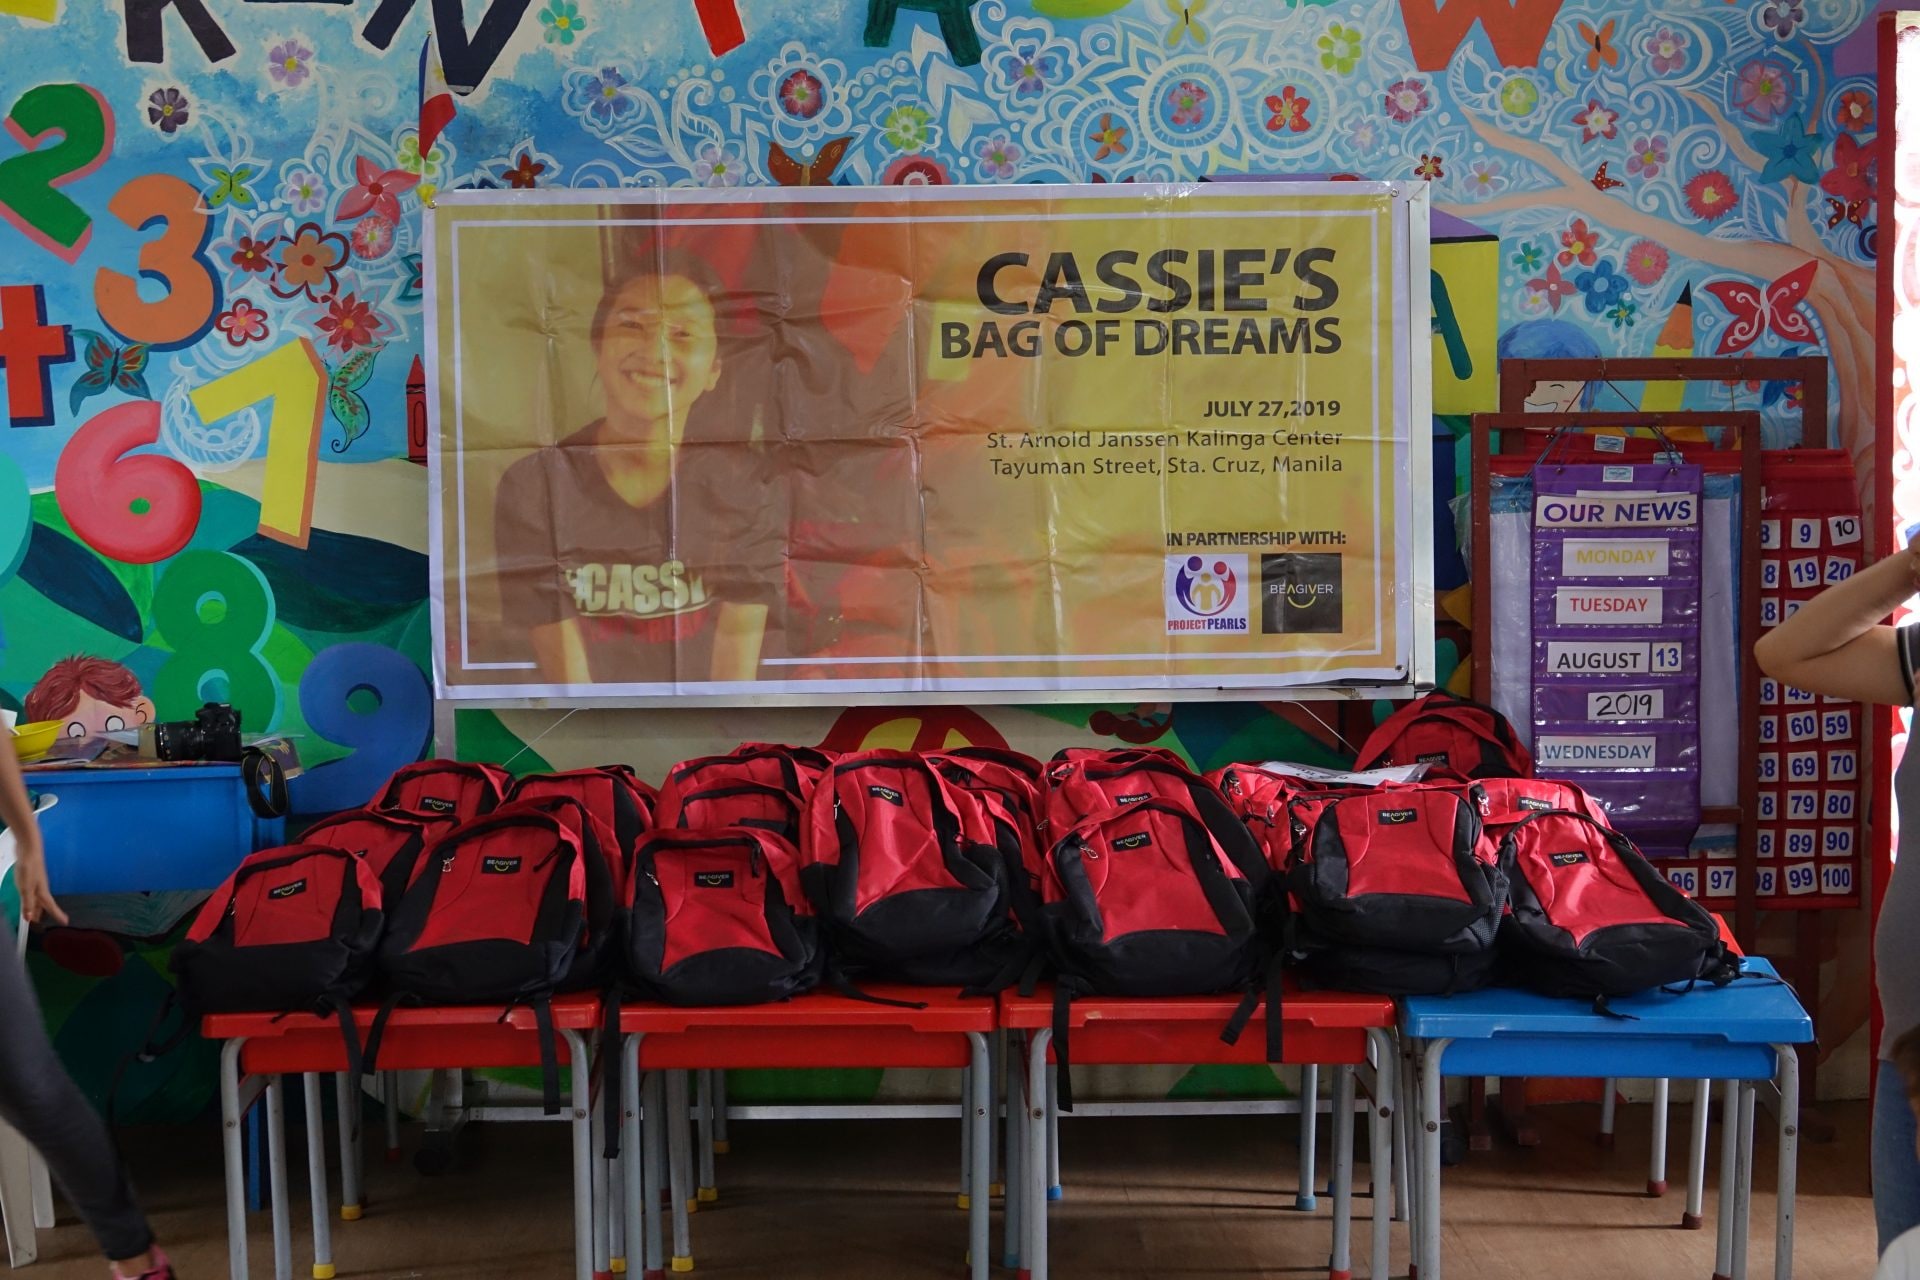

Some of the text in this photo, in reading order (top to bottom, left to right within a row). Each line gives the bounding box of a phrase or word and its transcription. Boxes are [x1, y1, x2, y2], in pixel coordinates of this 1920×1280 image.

[0, 83, 116, 265] 2
[94, 173, 224, 352] 3
[941, 316, 1342, 359] BAG OF DREAMS
[1203, 400, 1341, 418] JULY 27,2019
[189, 336, 328, 550] 7
[987, 429, 1342, 450] St. Arnold Janssen Kalinga Center
[990, 455, 1342, 480] Tayuman Street, Sta. Cruz, Manila
[55, 401, 202, 564] 6
[1543, 500, 1691, 523] OUR NEWS
[1166, 531, 1346, 547] IN PARTNERSHIP WITH:
[1800, 524, 1811, 543] 9
[1835, 519, 1855, 537] 10
[1576, 550, 1656, 564] MONDAY
[1793, 562, 1817, 583] 19
[1826, 561, 1851, 581] 20
[1270, 583, 1334, 595] BEAGIVER
[1569, 598, 1648, 612] TUESDAY
[1167, 617, 1247, 631] PROJECT PEARLS
[151, 549, 281, 735] 8
[1557, 647, 1679, 669] AUGUST 13
[1595, 693, 1652, 716] 2019
[299, 642, 433, 815] 9
[1791, 715, 1815, 736] 60
[1825, 715, 1848, 735] 59
[1544, 745, 1652, 760] WEDNESDAY
[1792, 757, 1816, 776] 69
[1831, 755, 1853, 774] 70
[423, 798, 453, 808] BEAGIVER
[871, 787, 899, 798] BEAGIVER
[1119, 795, 1149, 804] BEAGIVER
[1791, 795, 1815, 814] 79
[1827, 795, 1851, 814] 80
[1116, 834, 1146, 845] BEAGIVER
[1789, 834, 1813, 853] 89
[1826, 832, 1849, 851] 90
[273, 881, 303, 894] BEAGIVER
[1671, 872, 1695, 892] 96
[1710, 870, 1734, 889] 97
[1789, 868, 1813, 888] 99
[1822, 868, 1850, 887] 100
